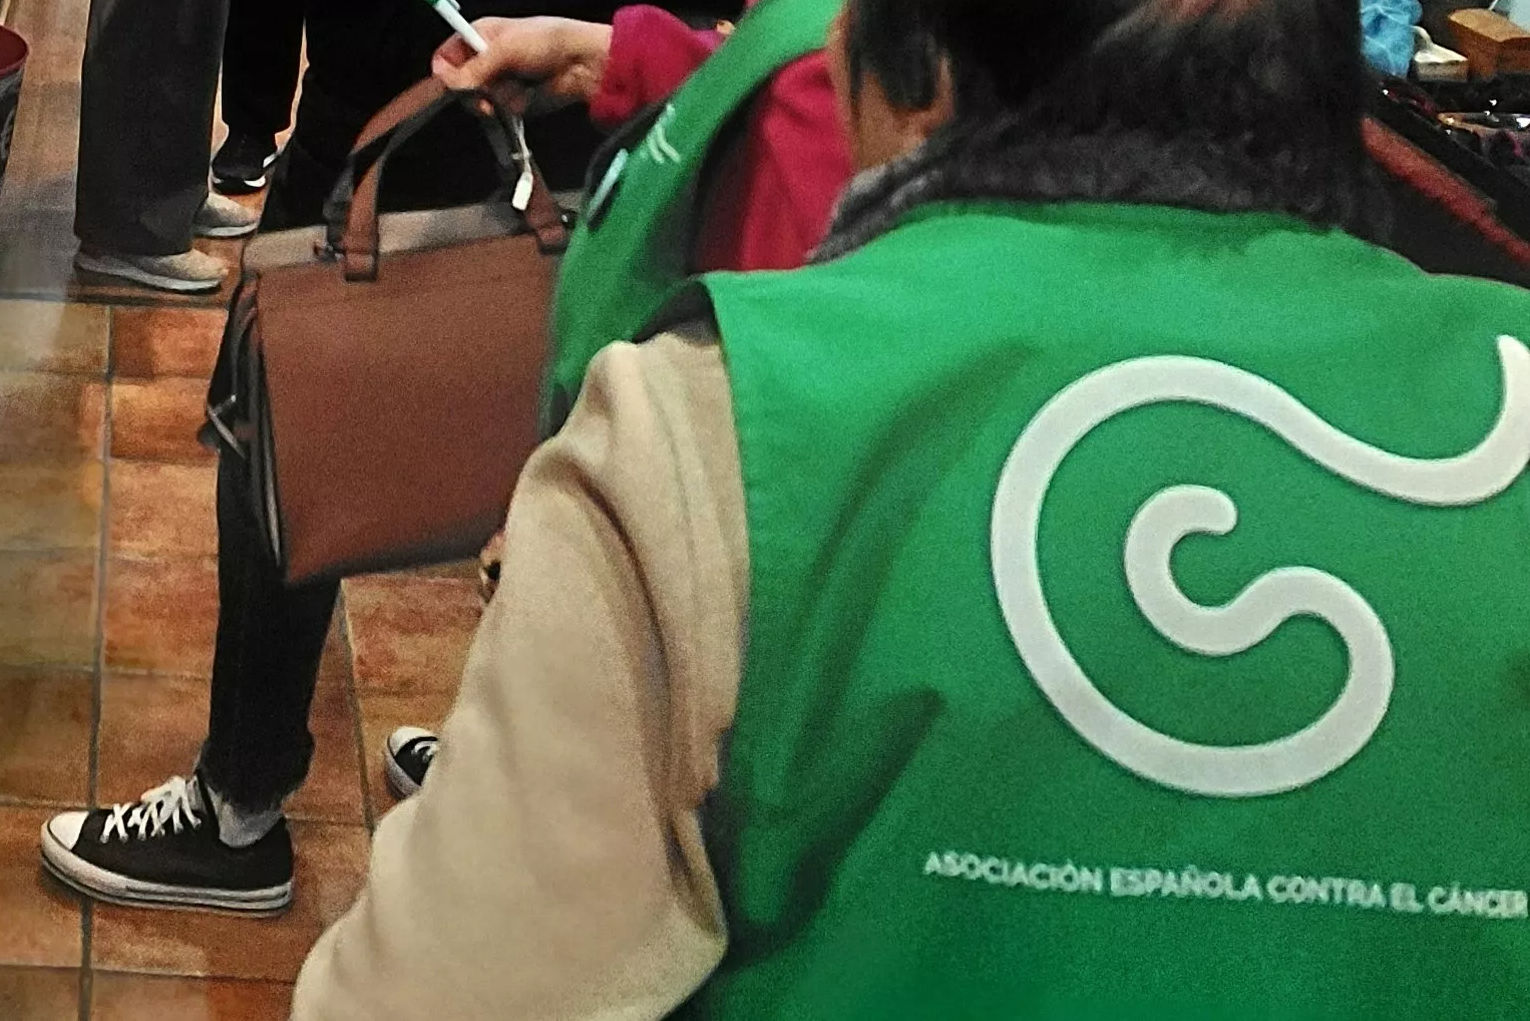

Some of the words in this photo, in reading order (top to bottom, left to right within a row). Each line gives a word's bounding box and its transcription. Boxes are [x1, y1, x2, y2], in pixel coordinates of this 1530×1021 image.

[924, 851, 1103, 893] ASOCIACIÓN
[1109, 864, 1263, 901] ESPAÑOLA
[1266, 875, 1386, 908] CONTRA
[1389, 882, 1424, 913] EL
[1426, 883, 1529, 919] CÁNCER
